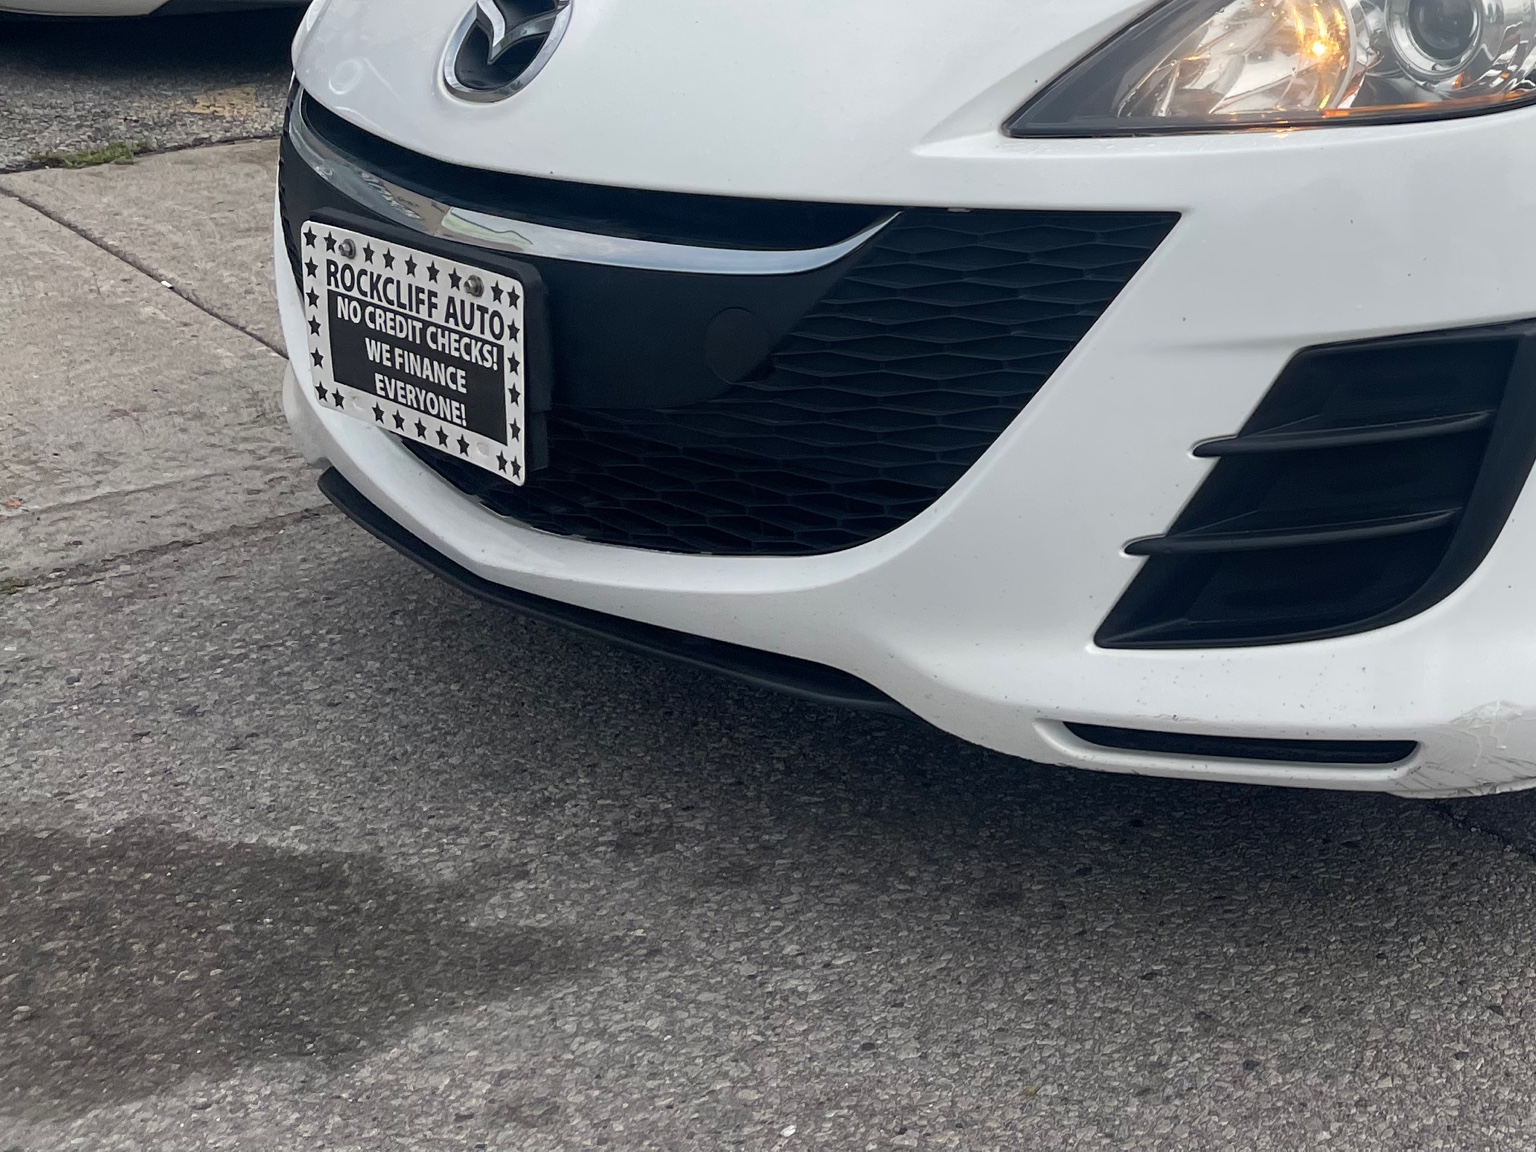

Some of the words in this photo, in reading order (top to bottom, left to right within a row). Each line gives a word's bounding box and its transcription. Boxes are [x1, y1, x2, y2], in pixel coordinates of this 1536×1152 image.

[326, 259, 438, 319] ROCKCLIFF
[444, 296, 504, 340] AUTO
[337, 296, 362, 324] NO
[364, 306, 423, 344] CREDIT
[426, 326, 498, 371] CHECKS!
[365, 337, 392, 368] WE
[394, 346, 467, 394] FINANCE
[374, 373, 467, 427] EVERYONE!
